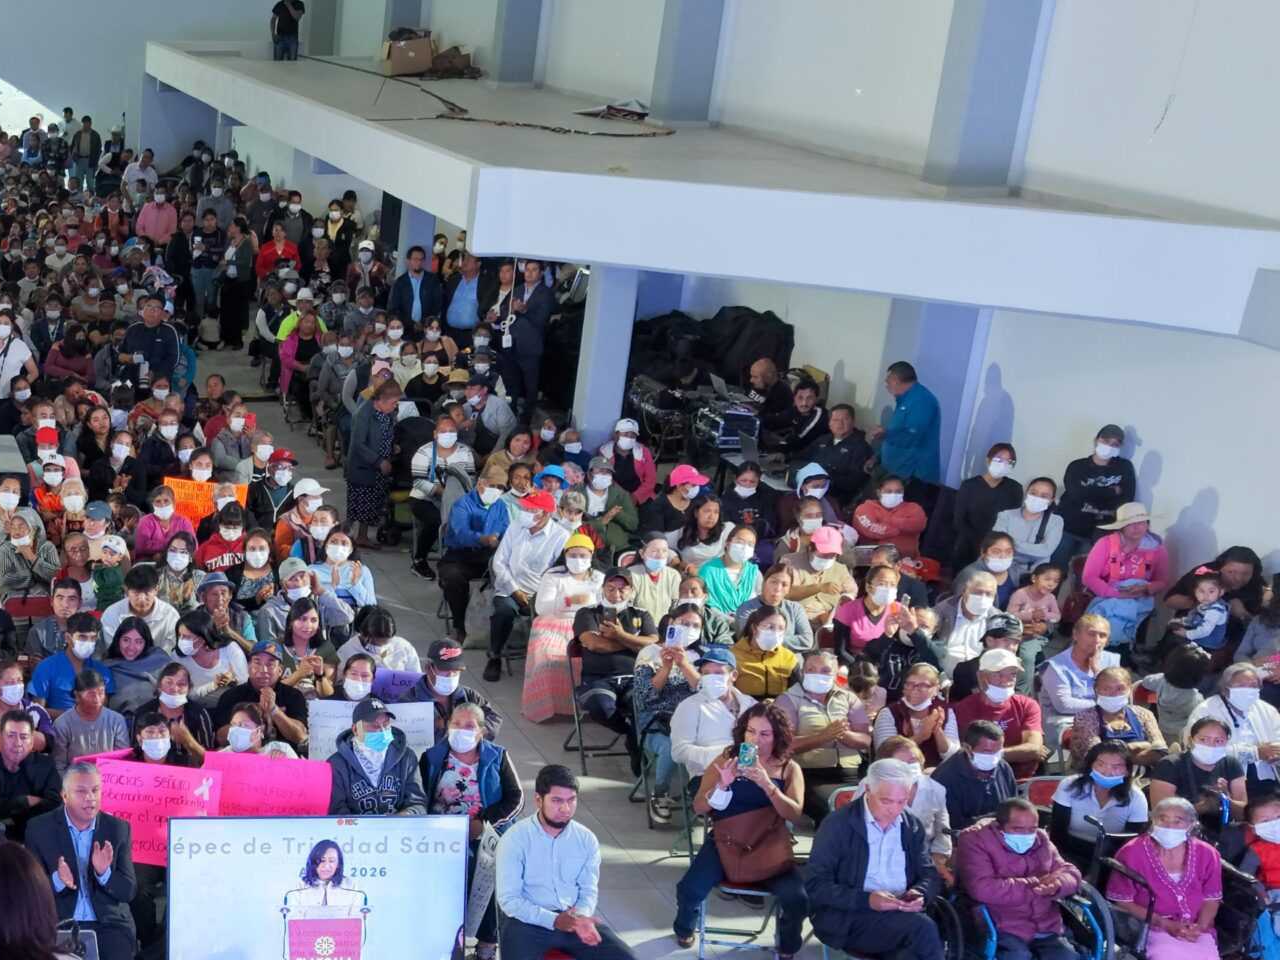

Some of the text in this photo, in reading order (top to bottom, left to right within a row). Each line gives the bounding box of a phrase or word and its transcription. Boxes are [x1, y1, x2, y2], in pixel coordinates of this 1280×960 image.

[243, 836, 272, 855] de
[282, 836, 388, 856] Tridad
[400, 834, 461, 855] Sánc
[350, 867, 387, 878] 2026
